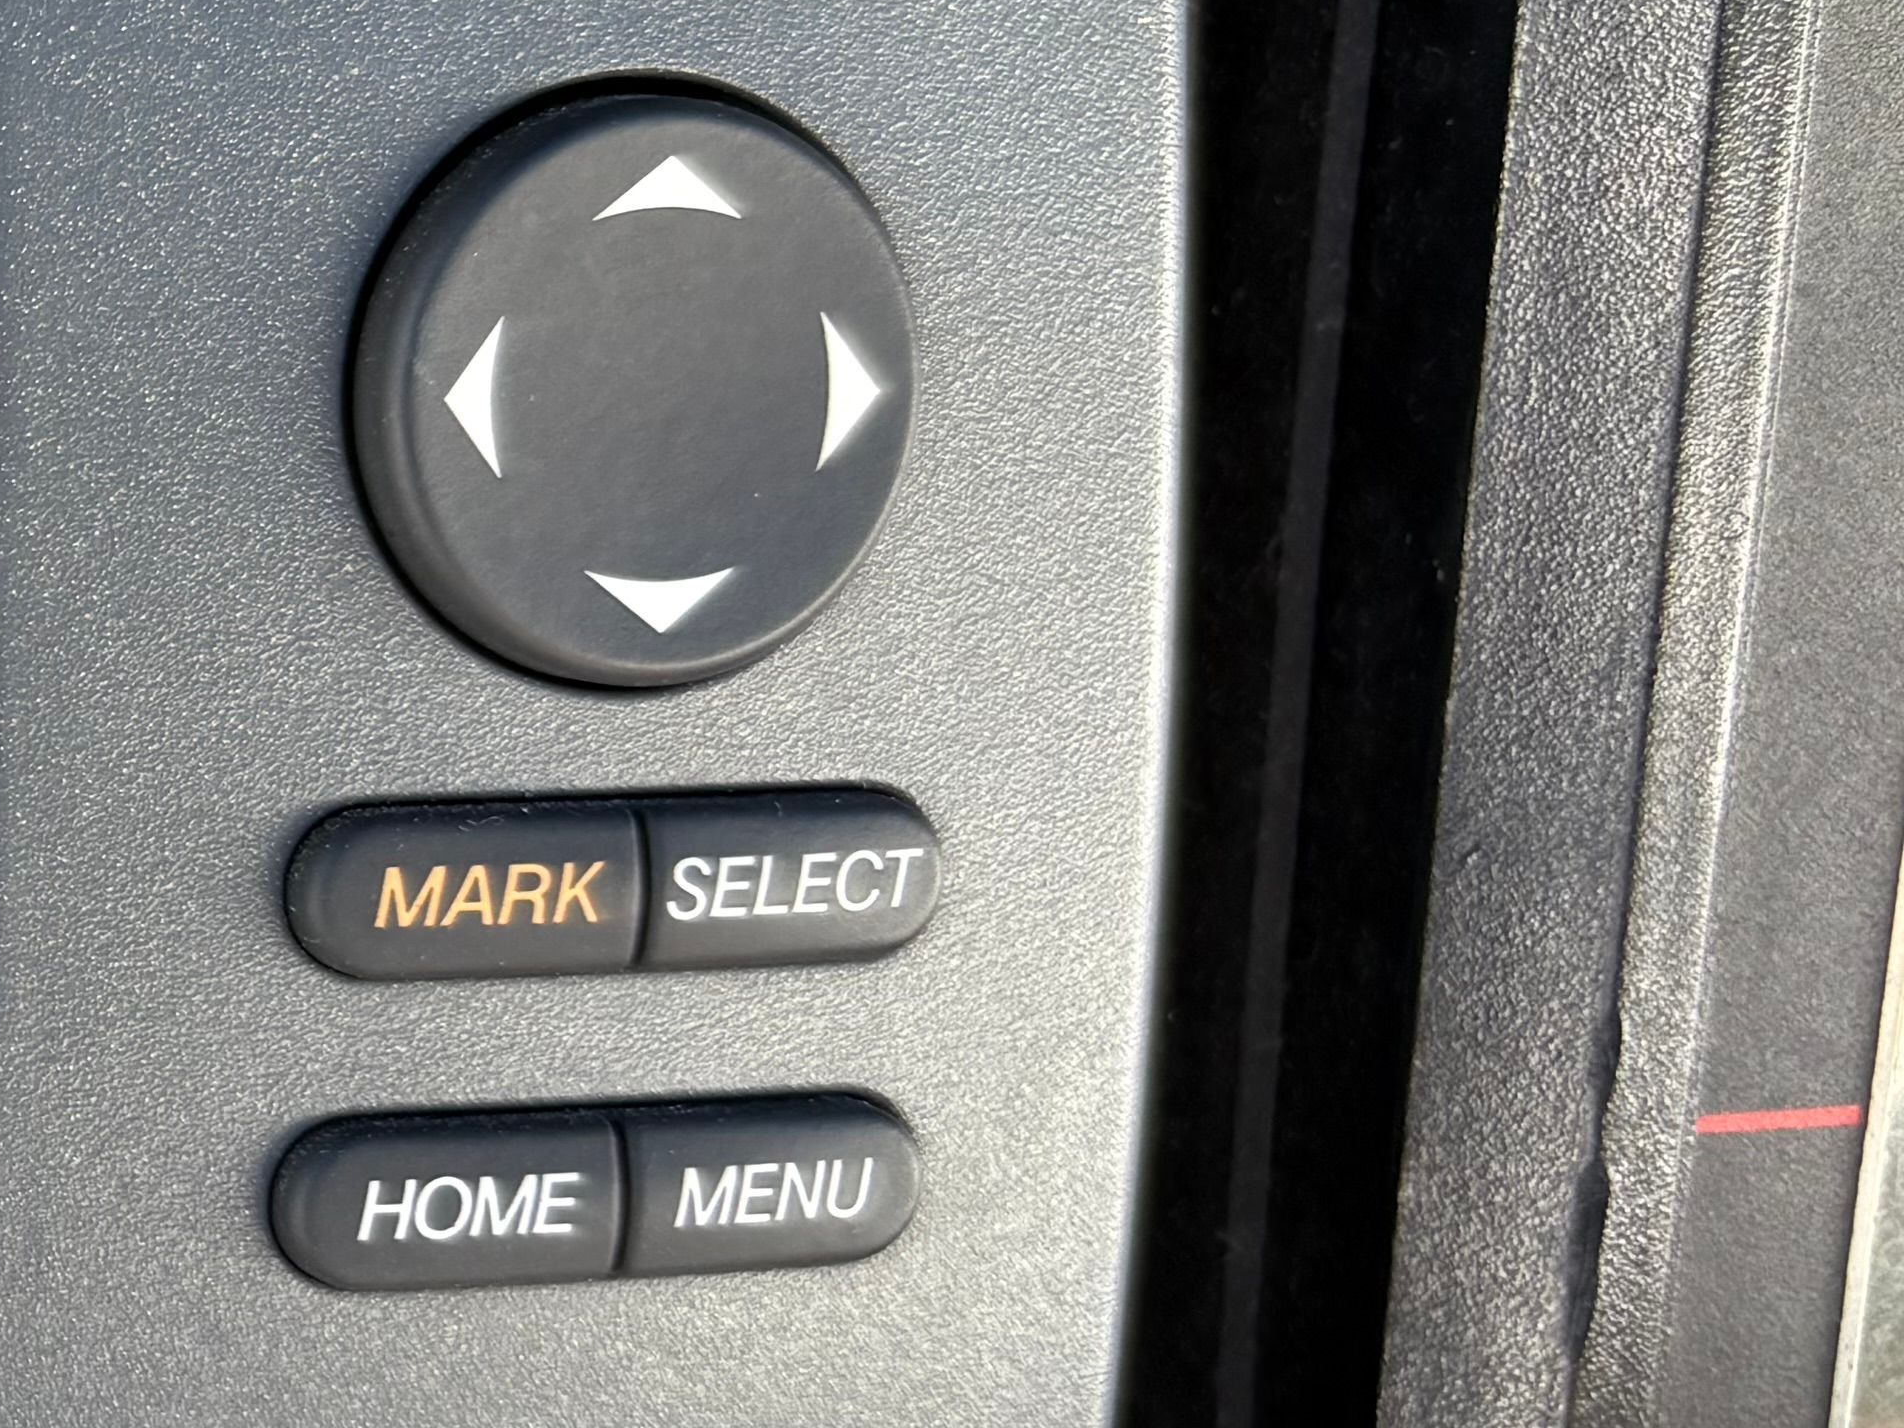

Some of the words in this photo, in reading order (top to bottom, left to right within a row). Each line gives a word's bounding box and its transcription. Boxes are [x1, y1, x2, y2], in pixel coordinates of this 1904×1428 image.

[374, 860, 606, 930] MARK
[665, 847, 924, 922] SELECT
[356, 1172, 582, 1242] HOME
[674, 1157, 874, 1228] MENU
